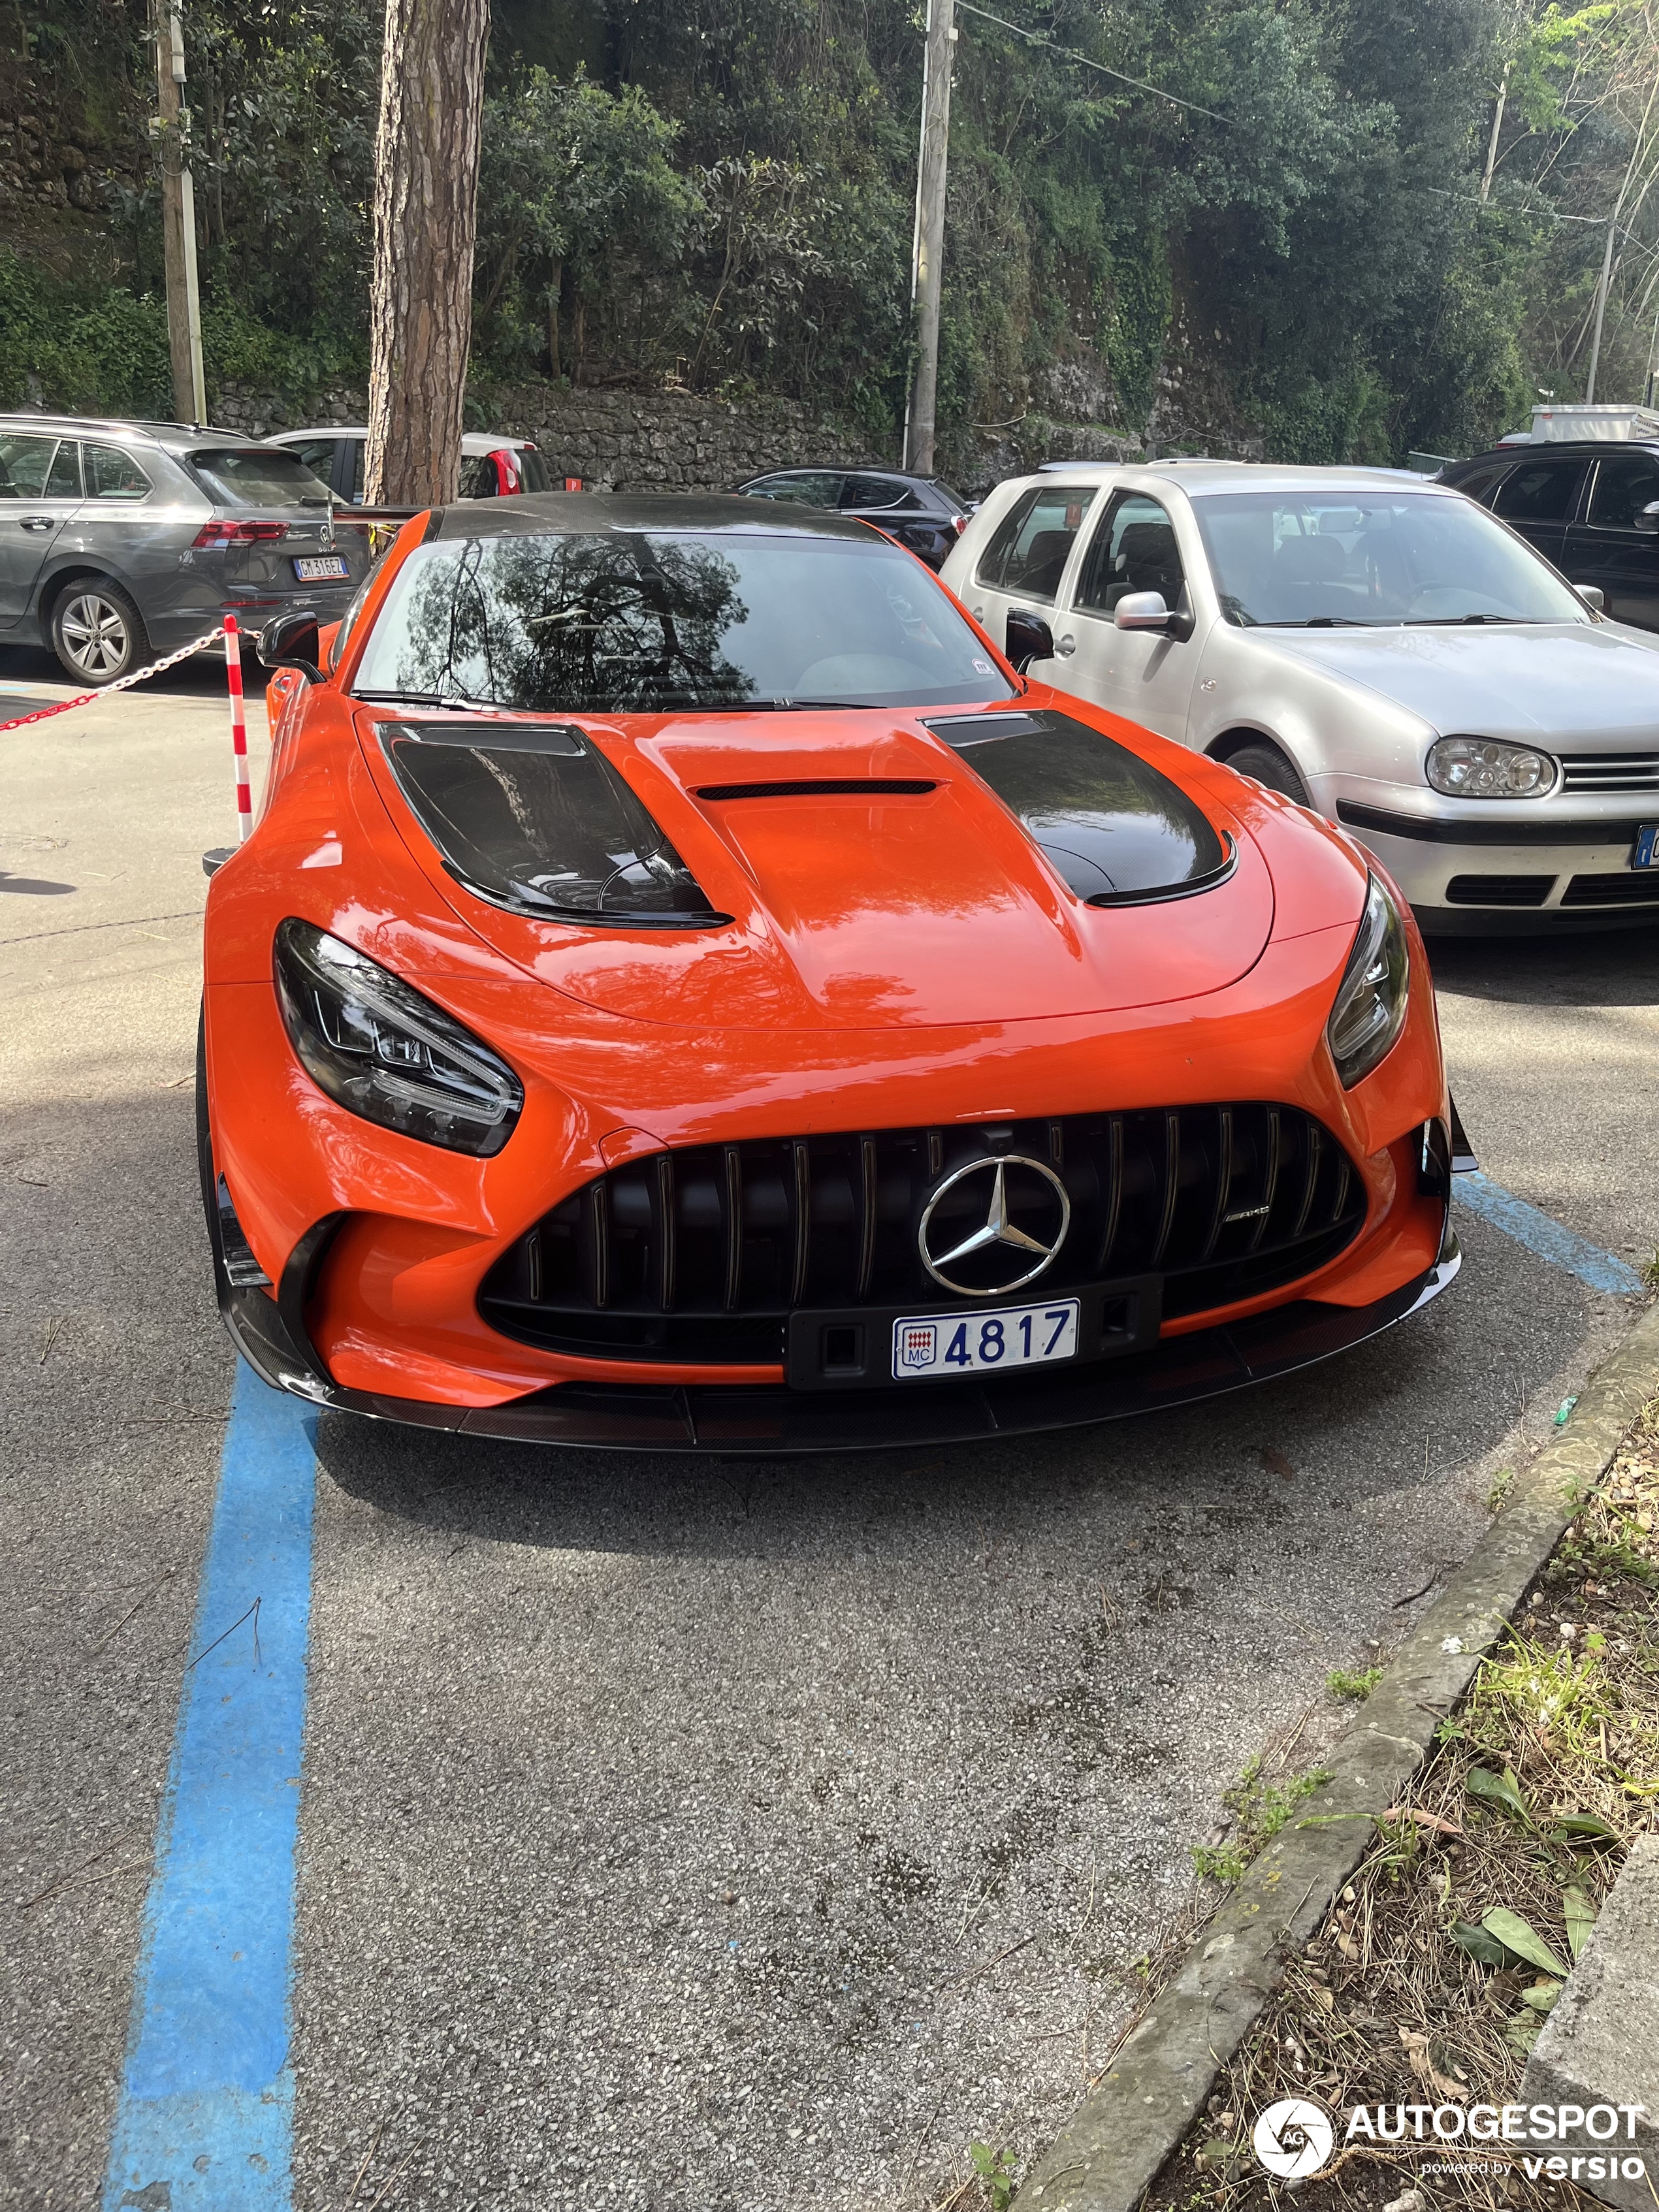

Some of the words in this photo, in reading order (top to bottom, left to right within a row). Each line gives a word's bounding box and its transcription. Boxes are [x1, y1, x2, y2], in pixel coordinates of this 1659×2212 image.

[314, 558, 342, 575] 316EZ
[1239, 1206, 1269, 1219] AMG
[945, 1309, 1070, 1366] 4817
[908, 1349, 930, 1362] MC
